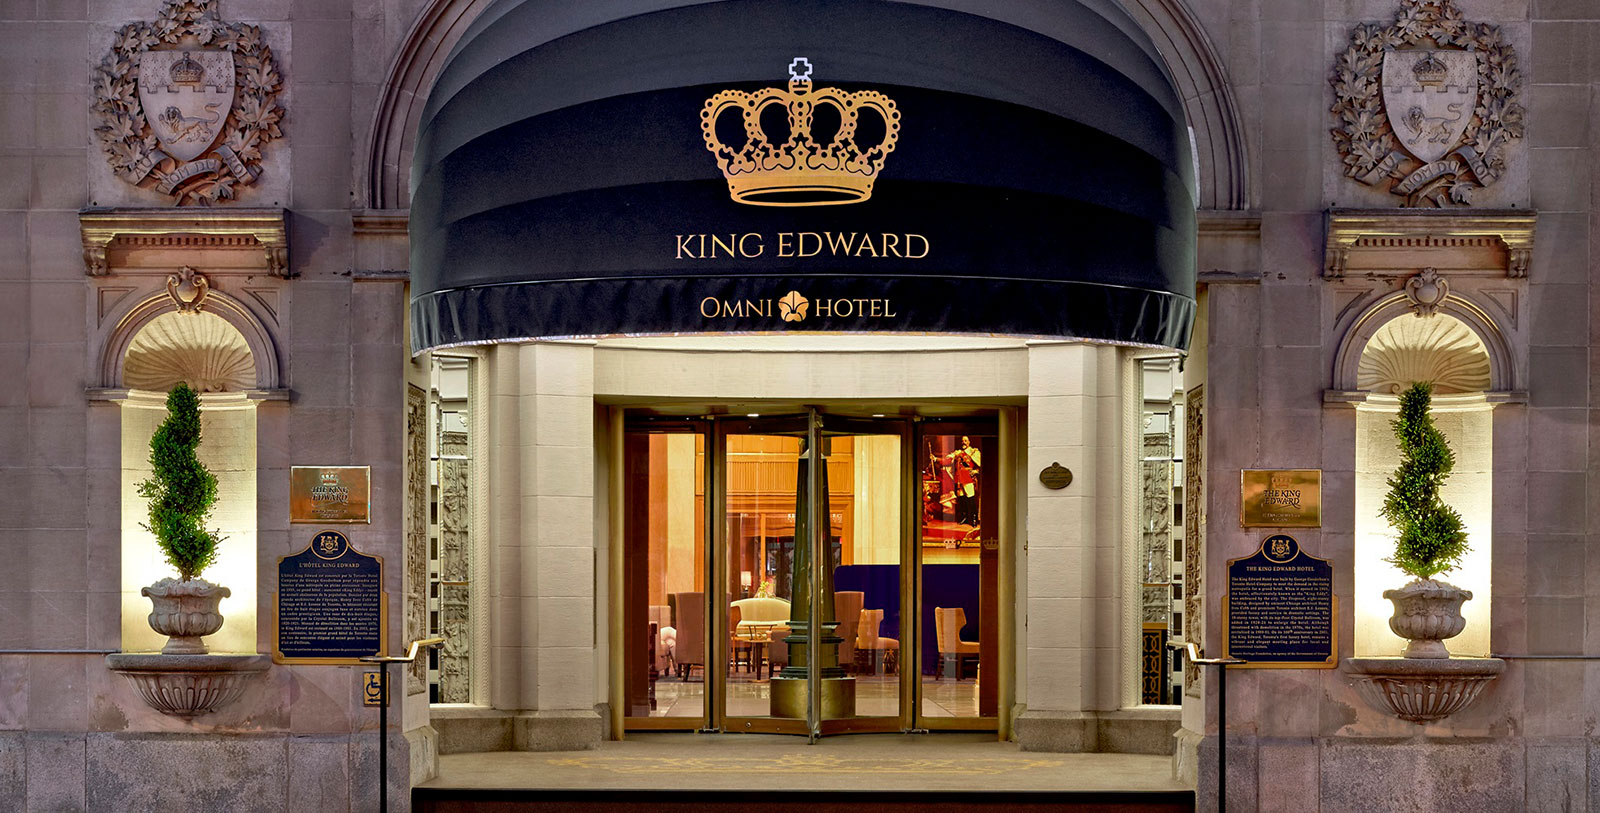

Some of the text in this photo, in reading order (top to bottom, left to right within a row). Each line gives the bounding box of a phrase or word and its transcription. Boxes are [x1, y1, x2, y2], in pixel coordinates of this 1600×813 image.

[134, 155, 153, 180] AU
[195, 158, 218, 172] DU
[1375, 154, 1396, 179] AU
[1403, 165, 1434, 192] NOM
[1437, 160, 1459, 173] DU
[675, 231, 930, 259] KING EDWARD
[699, 296, 897, 318] OMNI HOTEL
[328, 486, 349, 494] KING
[1263, 489, 1301, 498] THE KING
[312, 494, 349, 503] EDWARD
[1264, 497, 1301, 507] EDWARD
